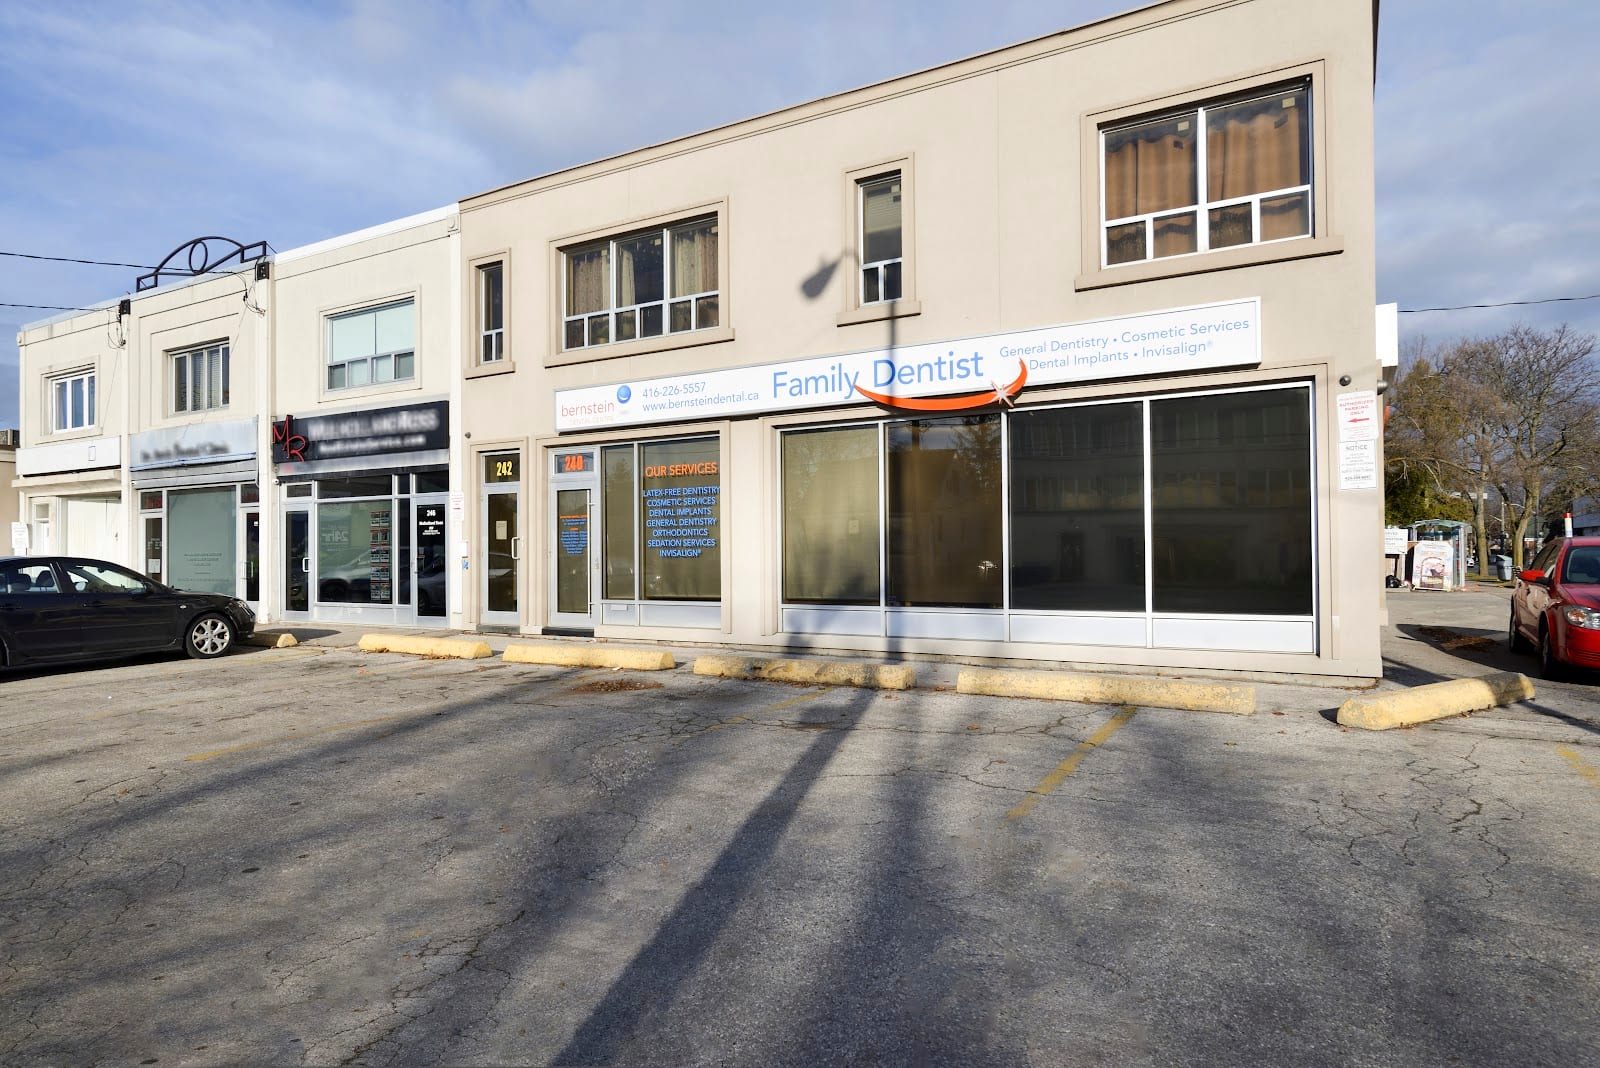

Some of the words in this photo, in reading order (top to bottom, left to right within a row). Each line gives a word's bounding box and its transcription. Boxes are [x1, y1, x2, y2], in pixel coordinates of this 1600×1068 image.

[999, 342, 1047, 358] General
[1050, 335, 1109, 352] Dentistry
[1121, 326, 1185, 343] Cosmetic
[1190, 318, 1250, 335] Services
[1029, 356, 1070, 371] Dental
[1074, 349, 1129, 367] Implants
[773, 363, 860, 399] Family
[873, 351, 984, 388] Dentist
[642, 382, 706, 398] 416-226-5557
[561, 400, 615, 417] bernstein
[642, 391, 759, 412] www.bernsteindental.ca
[496, 461, 513, 477] 242
[565, 455, 585, 472] 240
[645, 465, 667, 477] OUR
[669, 462, 717, 476] SERVICES
[643, 488, 681, 497] LATEX-FREE
[683, 486, 720, 495] DENTISTRY
[647, 499, 682, 507] COSMETIC
[684, 497, 716, 505] SERVICES
[649, 509, 675, 517] DENTAL
[677, 507, 712, 516] IMPLANTS
[679, 517, 717, 526] DENTISTRY
[652, 528, 708, 537] ORTHODONTICS
[647, 539, 681, 547] SEDATION
[683, 538, 716, 547] SERVICES
